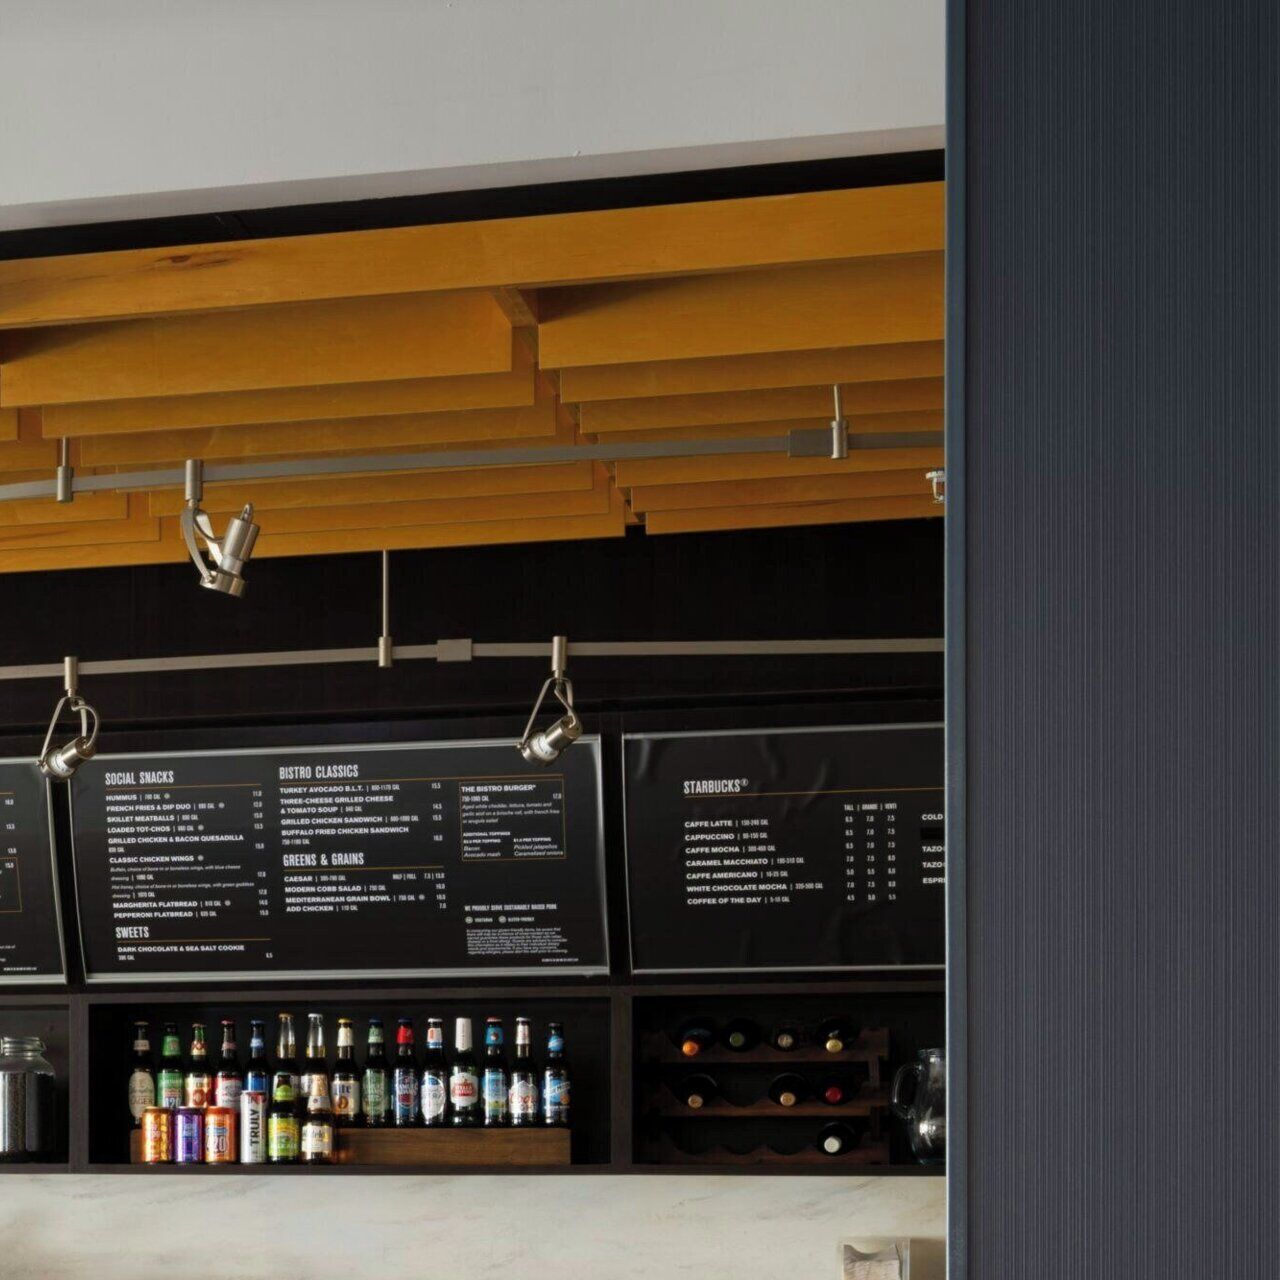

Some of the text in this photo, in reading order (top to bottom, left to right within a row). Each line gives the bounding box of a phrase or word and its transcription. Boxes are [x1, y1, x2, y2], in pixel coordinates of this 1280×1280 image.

[105, 771, 174, 785] SOCIAL SNACKS
[279, 765, 358, 779] BISTRO CLASSICS
[283, 853, 364, 866] GREENS & GRAINS
[115, 926, 149, 938] SWEETS
[250, 1109, 260, 1147] TRULY
